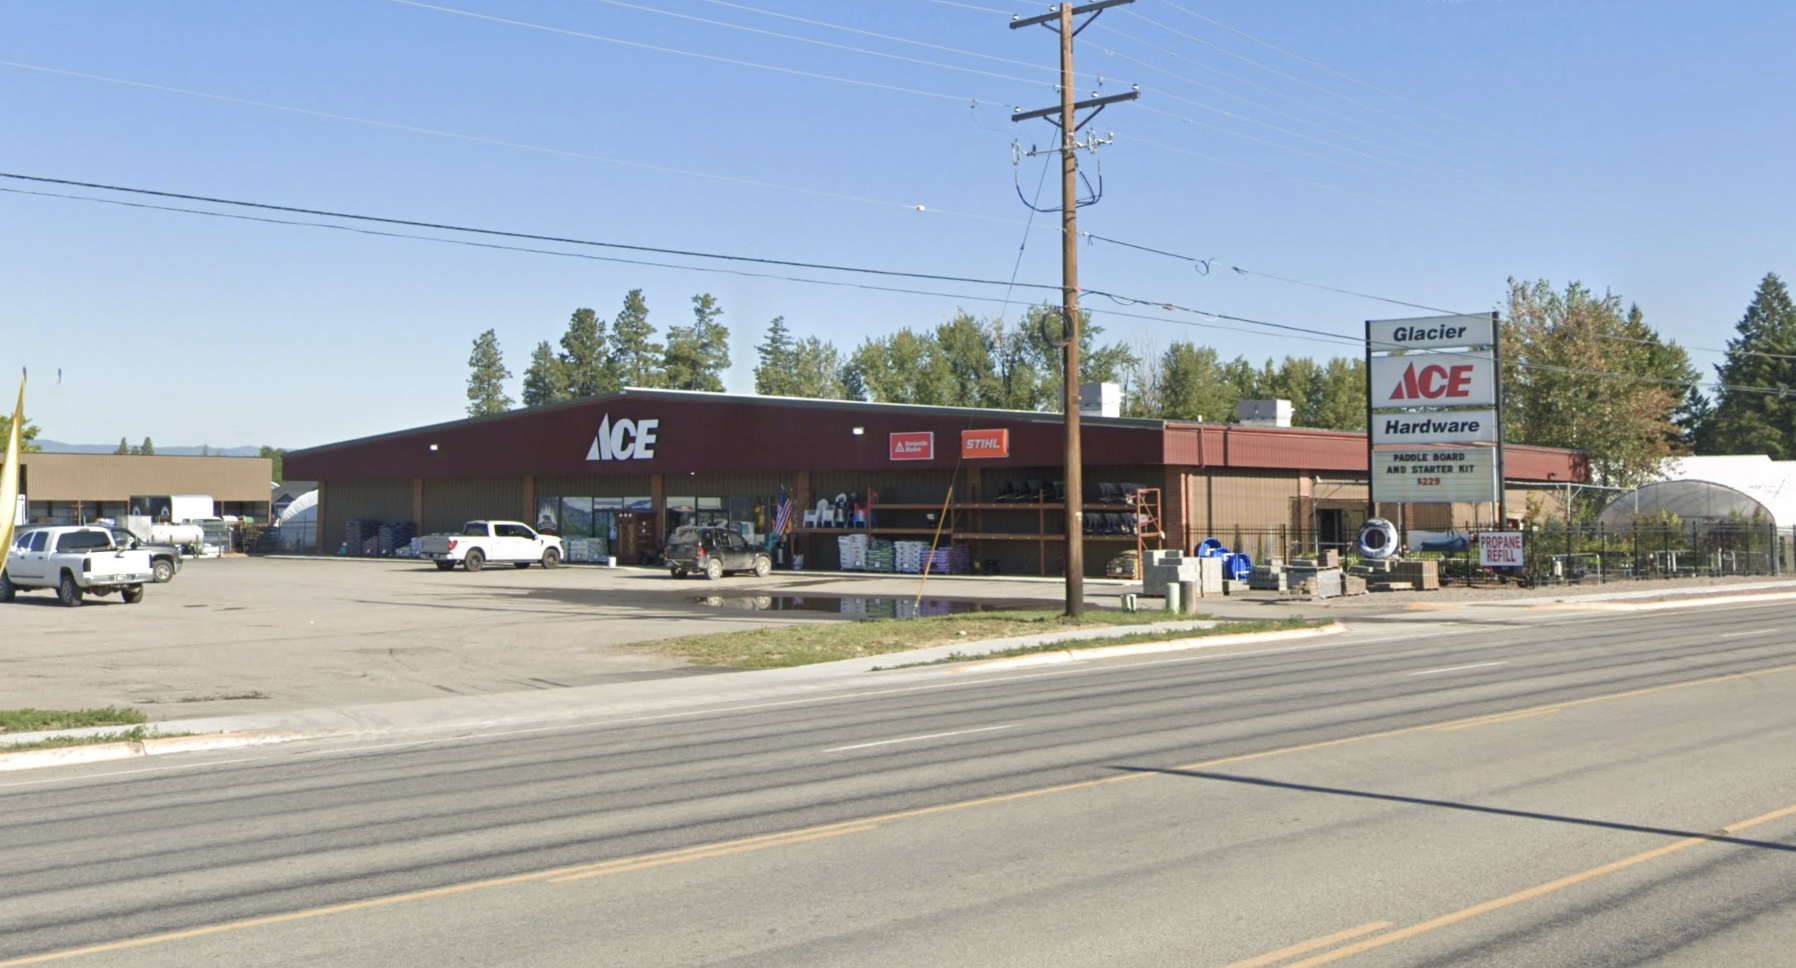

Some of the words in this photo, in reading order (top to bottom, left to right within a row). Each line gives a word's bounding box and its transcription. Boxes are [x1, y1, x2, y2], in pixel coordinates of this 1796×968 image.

[1393, 324, 1467, 342] Glacier
[1389, 361, 1474, 400] ACE
[1385, 419, 1480, 435] Hardware
[586, 412, 659, 461] ACE
[966, 438, 1000, 449] STIHL
[1393, 453, 1428, 462] PADDLE
[1433, 453, 1465, 461] BOARD
[1386, 465, 1406, 474] AND
[1411, 465, 1453, 473] STARTER
[1458, 465, 1475, 473] KIT
[1417, 477, 1441, 486] $229
[1481, 536, 1521, 549] PROPANE
[1486, 549, 1516, 562] REFILL
